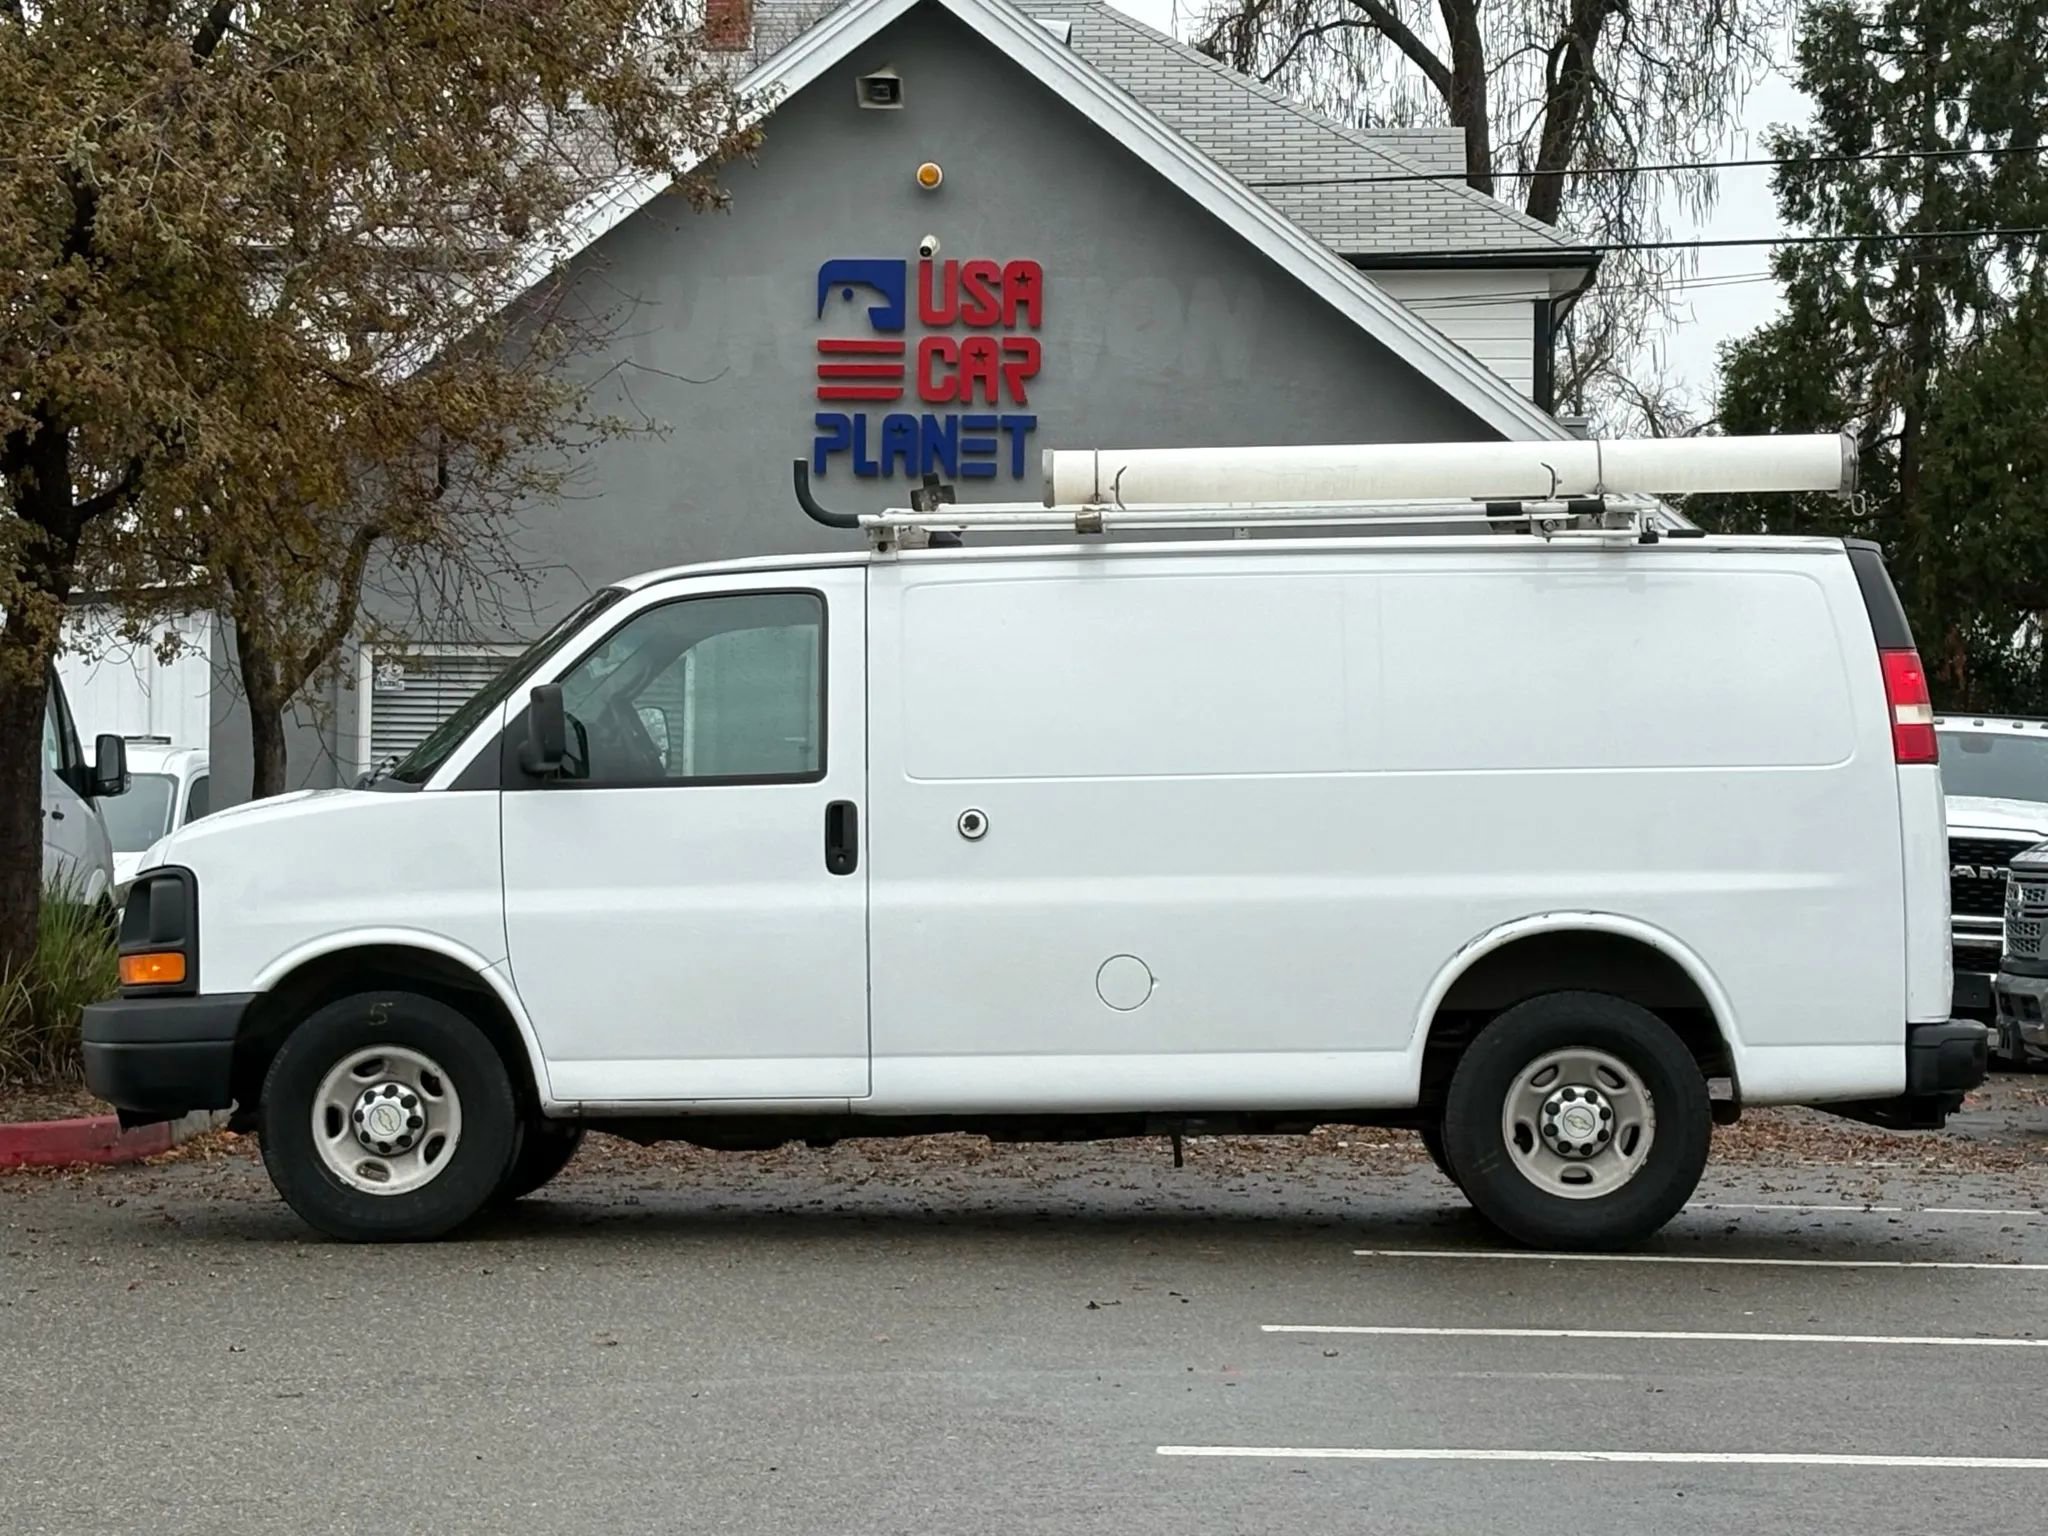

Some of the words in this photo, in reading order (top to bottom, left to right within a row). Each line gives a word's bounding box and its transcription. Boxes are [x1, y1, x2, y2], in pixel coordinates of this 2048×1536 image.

[918, 260, 1043, 328] USA
[917, 336, 1041, 404] CAR
[814, 413, 1038, 479] PLANET
[1950, 865, 2011, 879] AM
